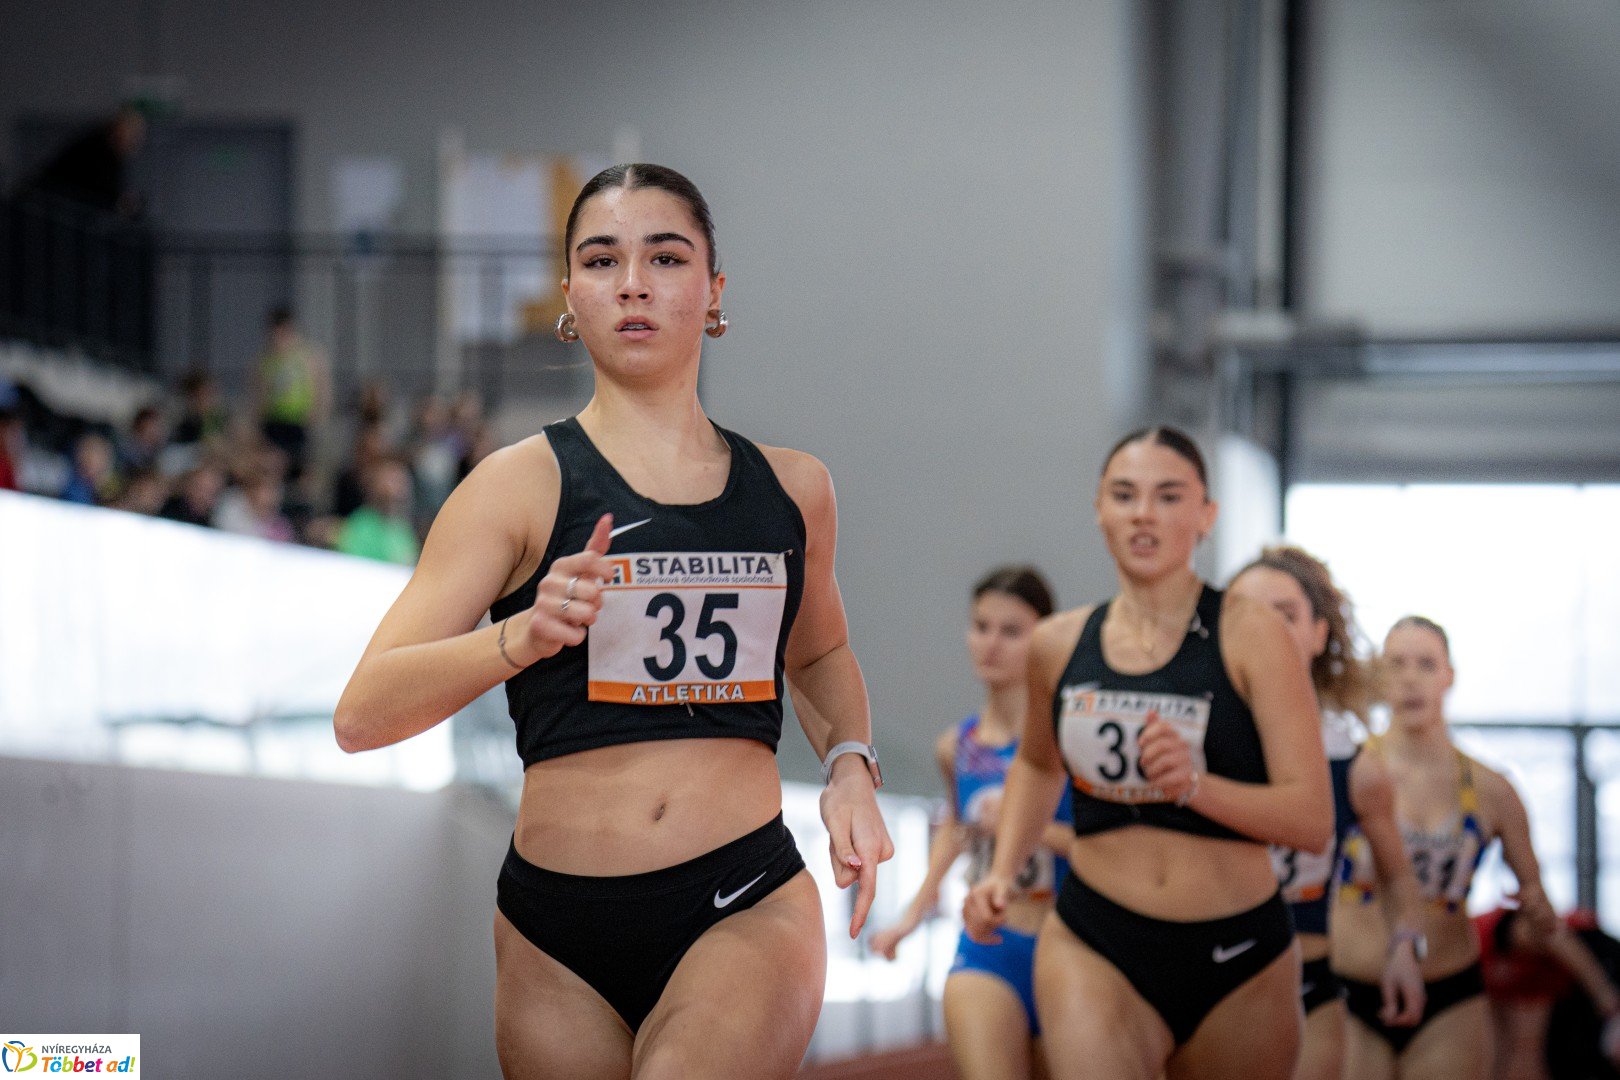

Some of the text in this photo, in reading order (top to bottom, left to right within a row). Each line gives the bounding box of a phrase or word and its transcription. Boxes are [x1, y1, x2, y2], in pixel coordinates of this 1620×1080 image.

[636, 556, 773, 575] STABILITA
[643, 592, 739, 682] 35
[631, 685, 745, 703] ATLETIKA
[1097, 721, 1150, 783] 3
